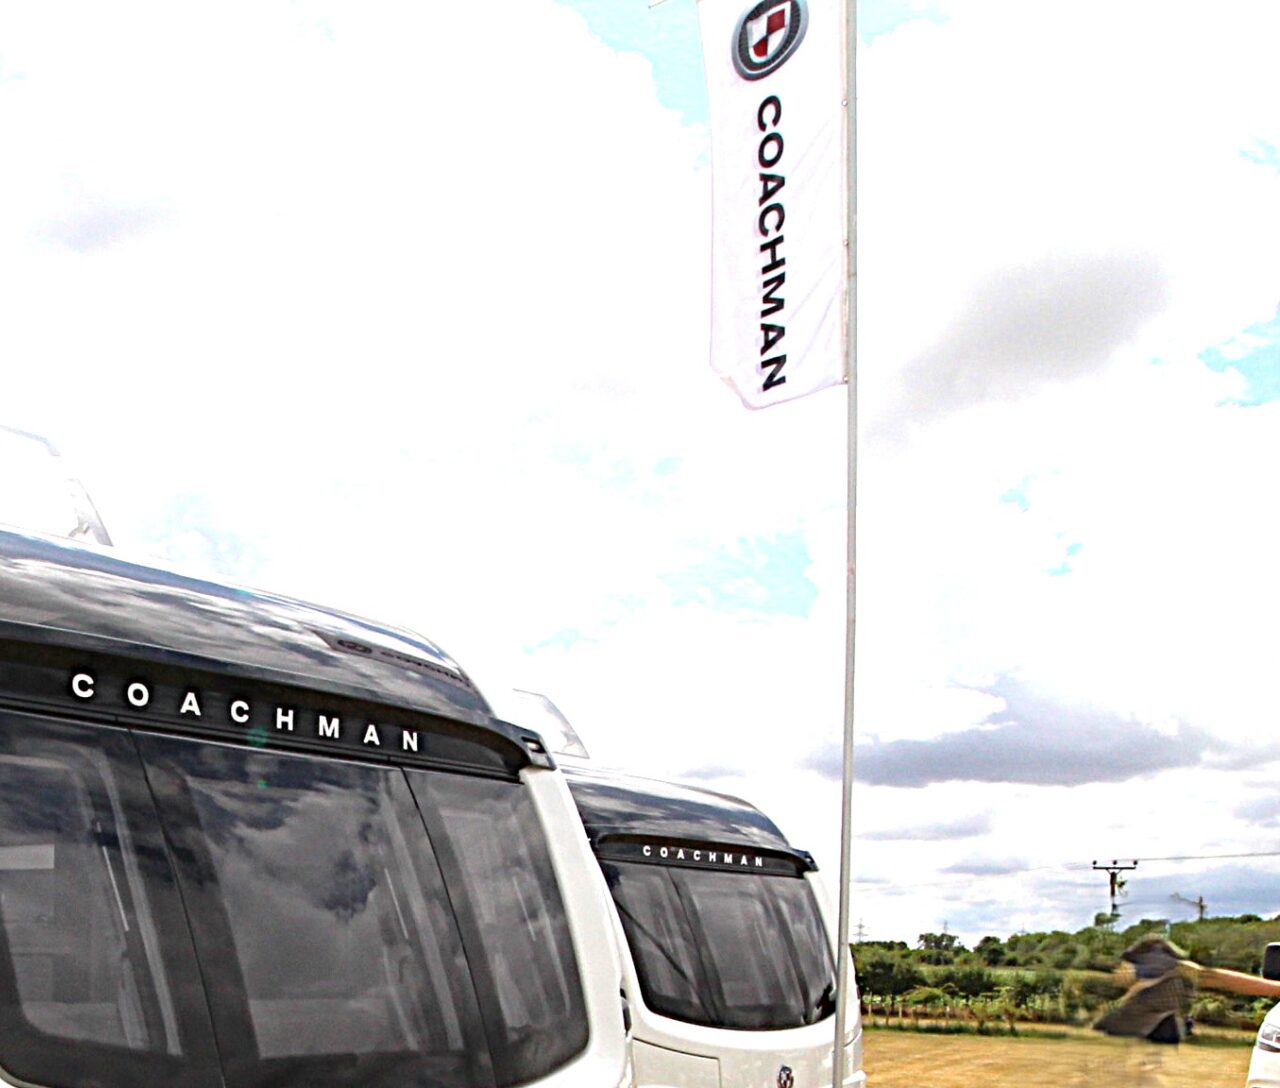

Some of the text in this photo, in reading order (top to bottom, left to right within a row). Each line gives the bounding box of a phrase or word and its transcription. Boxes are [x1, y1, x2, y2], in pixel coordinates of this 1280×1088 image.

[757, 95, 787, 392] COACHMAN
[71, 673, 419, 752] COACHMAN
[642, 845, 763, 867] COACHMAN
